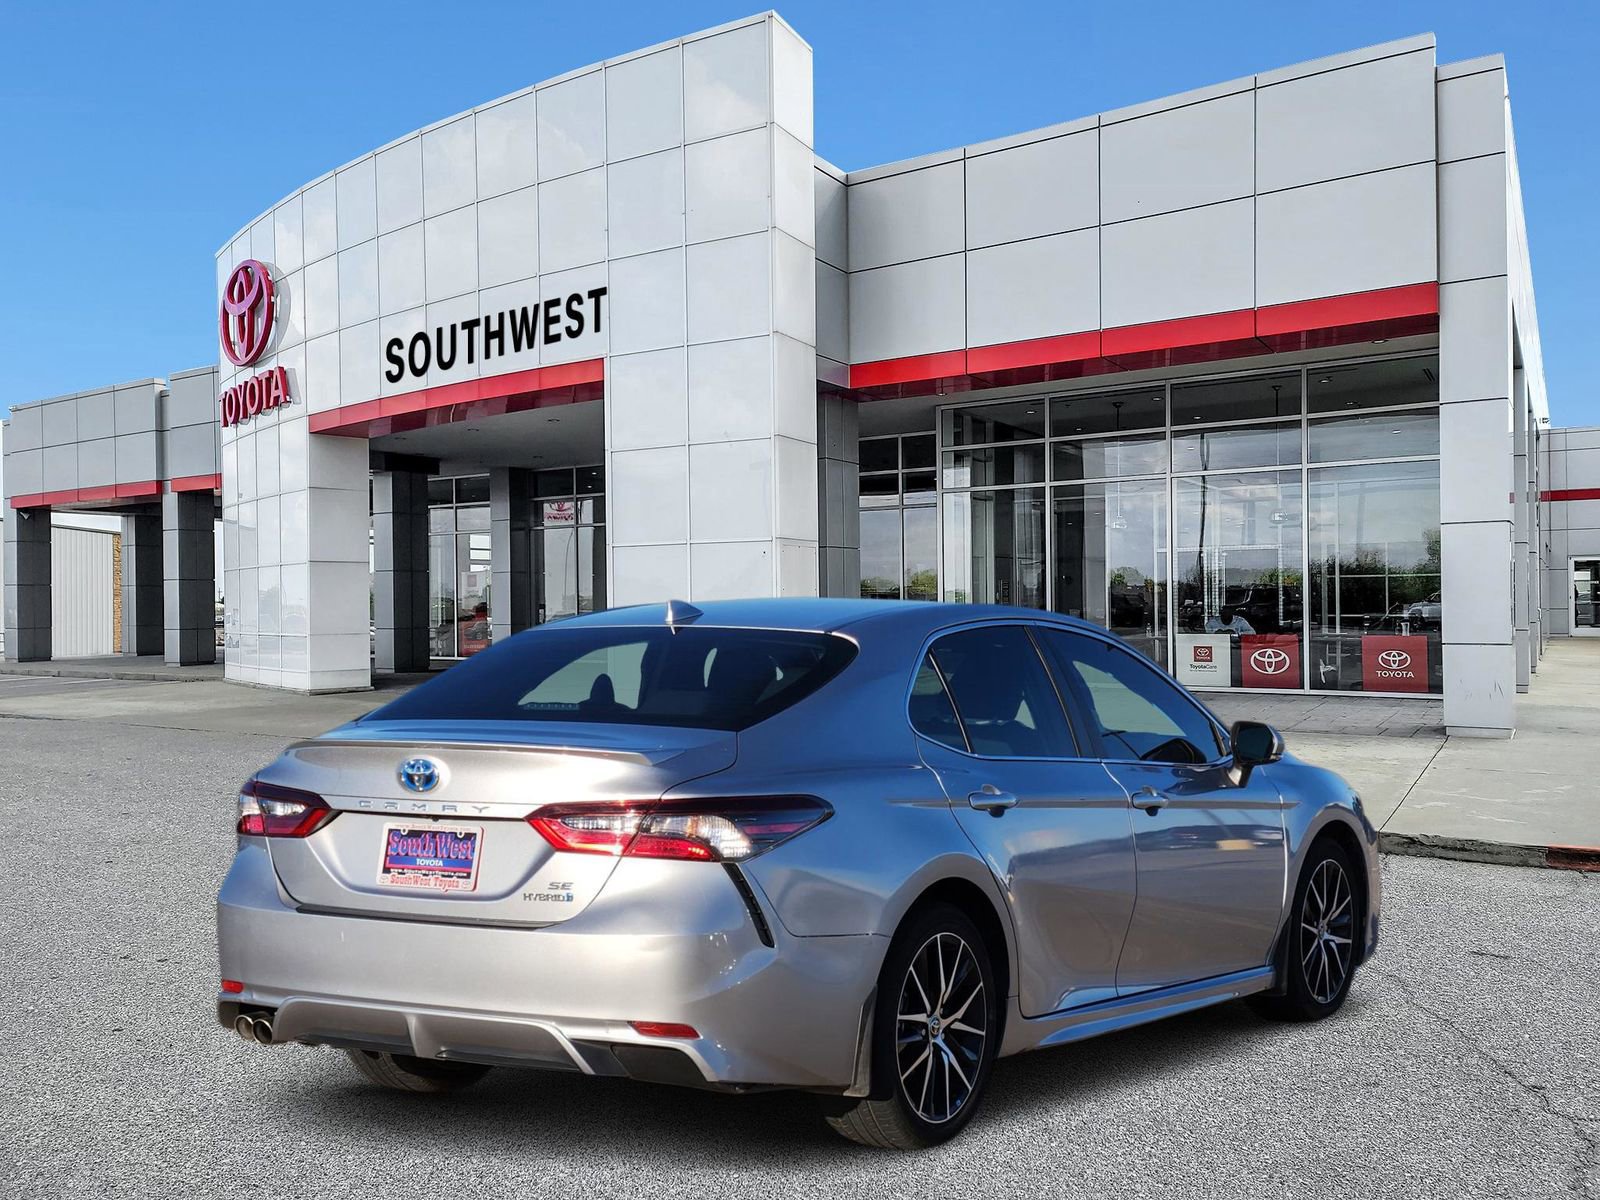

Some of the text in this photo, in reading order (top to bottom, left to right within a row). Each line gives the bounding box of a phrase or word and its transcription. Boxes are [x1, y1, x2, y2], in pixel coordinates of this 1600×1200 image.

[385, 286, 608, 384] SOUTHWEST
[219, 366, 291, 427] TOYOTA
[1376, 670, 1414, 678] TOYOTA
[359, 799, 490, 813] CAMRY
[416, 858, 443, 867] TOYOTA
[432, 876, 459, 889] Toyota
[548, 882, 574, 890] SE
[523, 893, 565, 902] HYBRID
